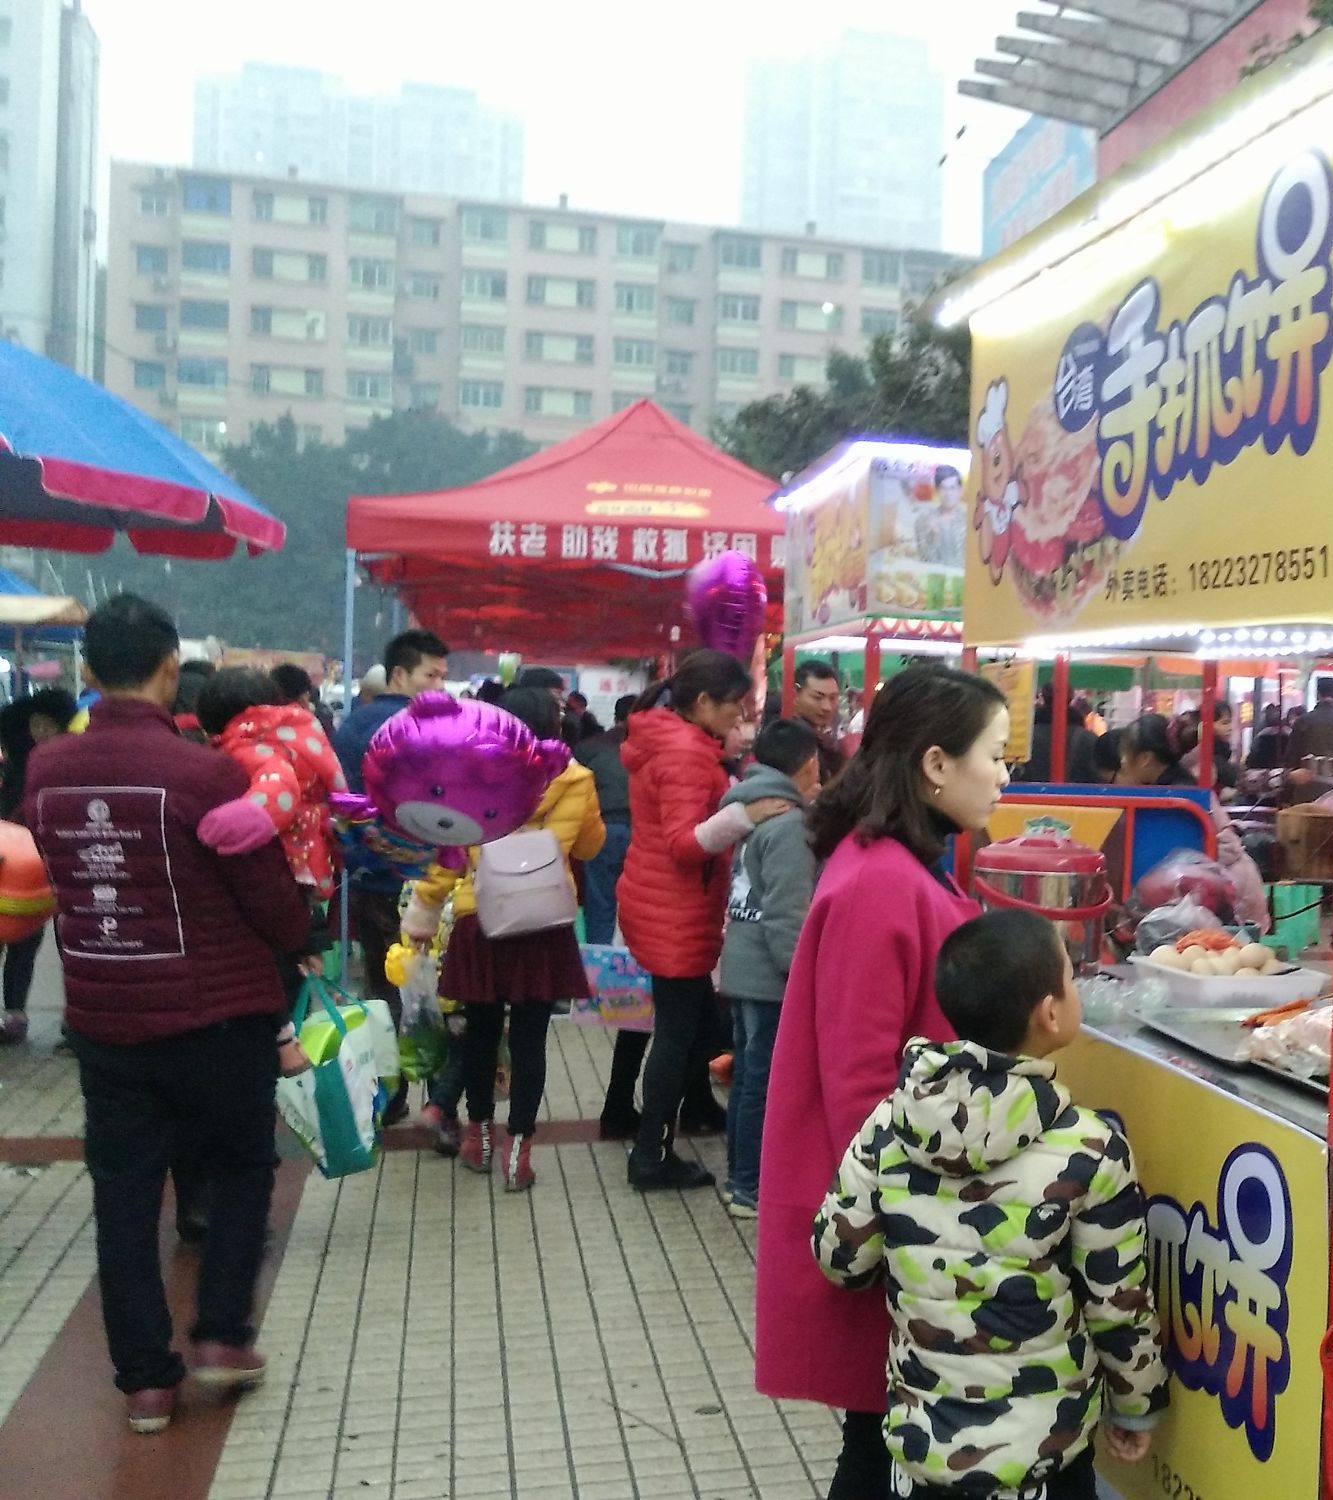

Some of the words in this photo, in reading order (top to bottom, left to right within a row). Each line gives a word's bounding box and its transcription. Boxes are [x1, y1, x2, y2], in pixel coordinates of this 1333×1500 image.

[1100, 150, 1330, 517] 手抓饼
[489, 521, 548, 558] 扶老
[561, 524, 619, 561] 助残
[1187, 545, 1330, 593] 18223278551
[1146, 1150, 1284, 1431] 抓饼
